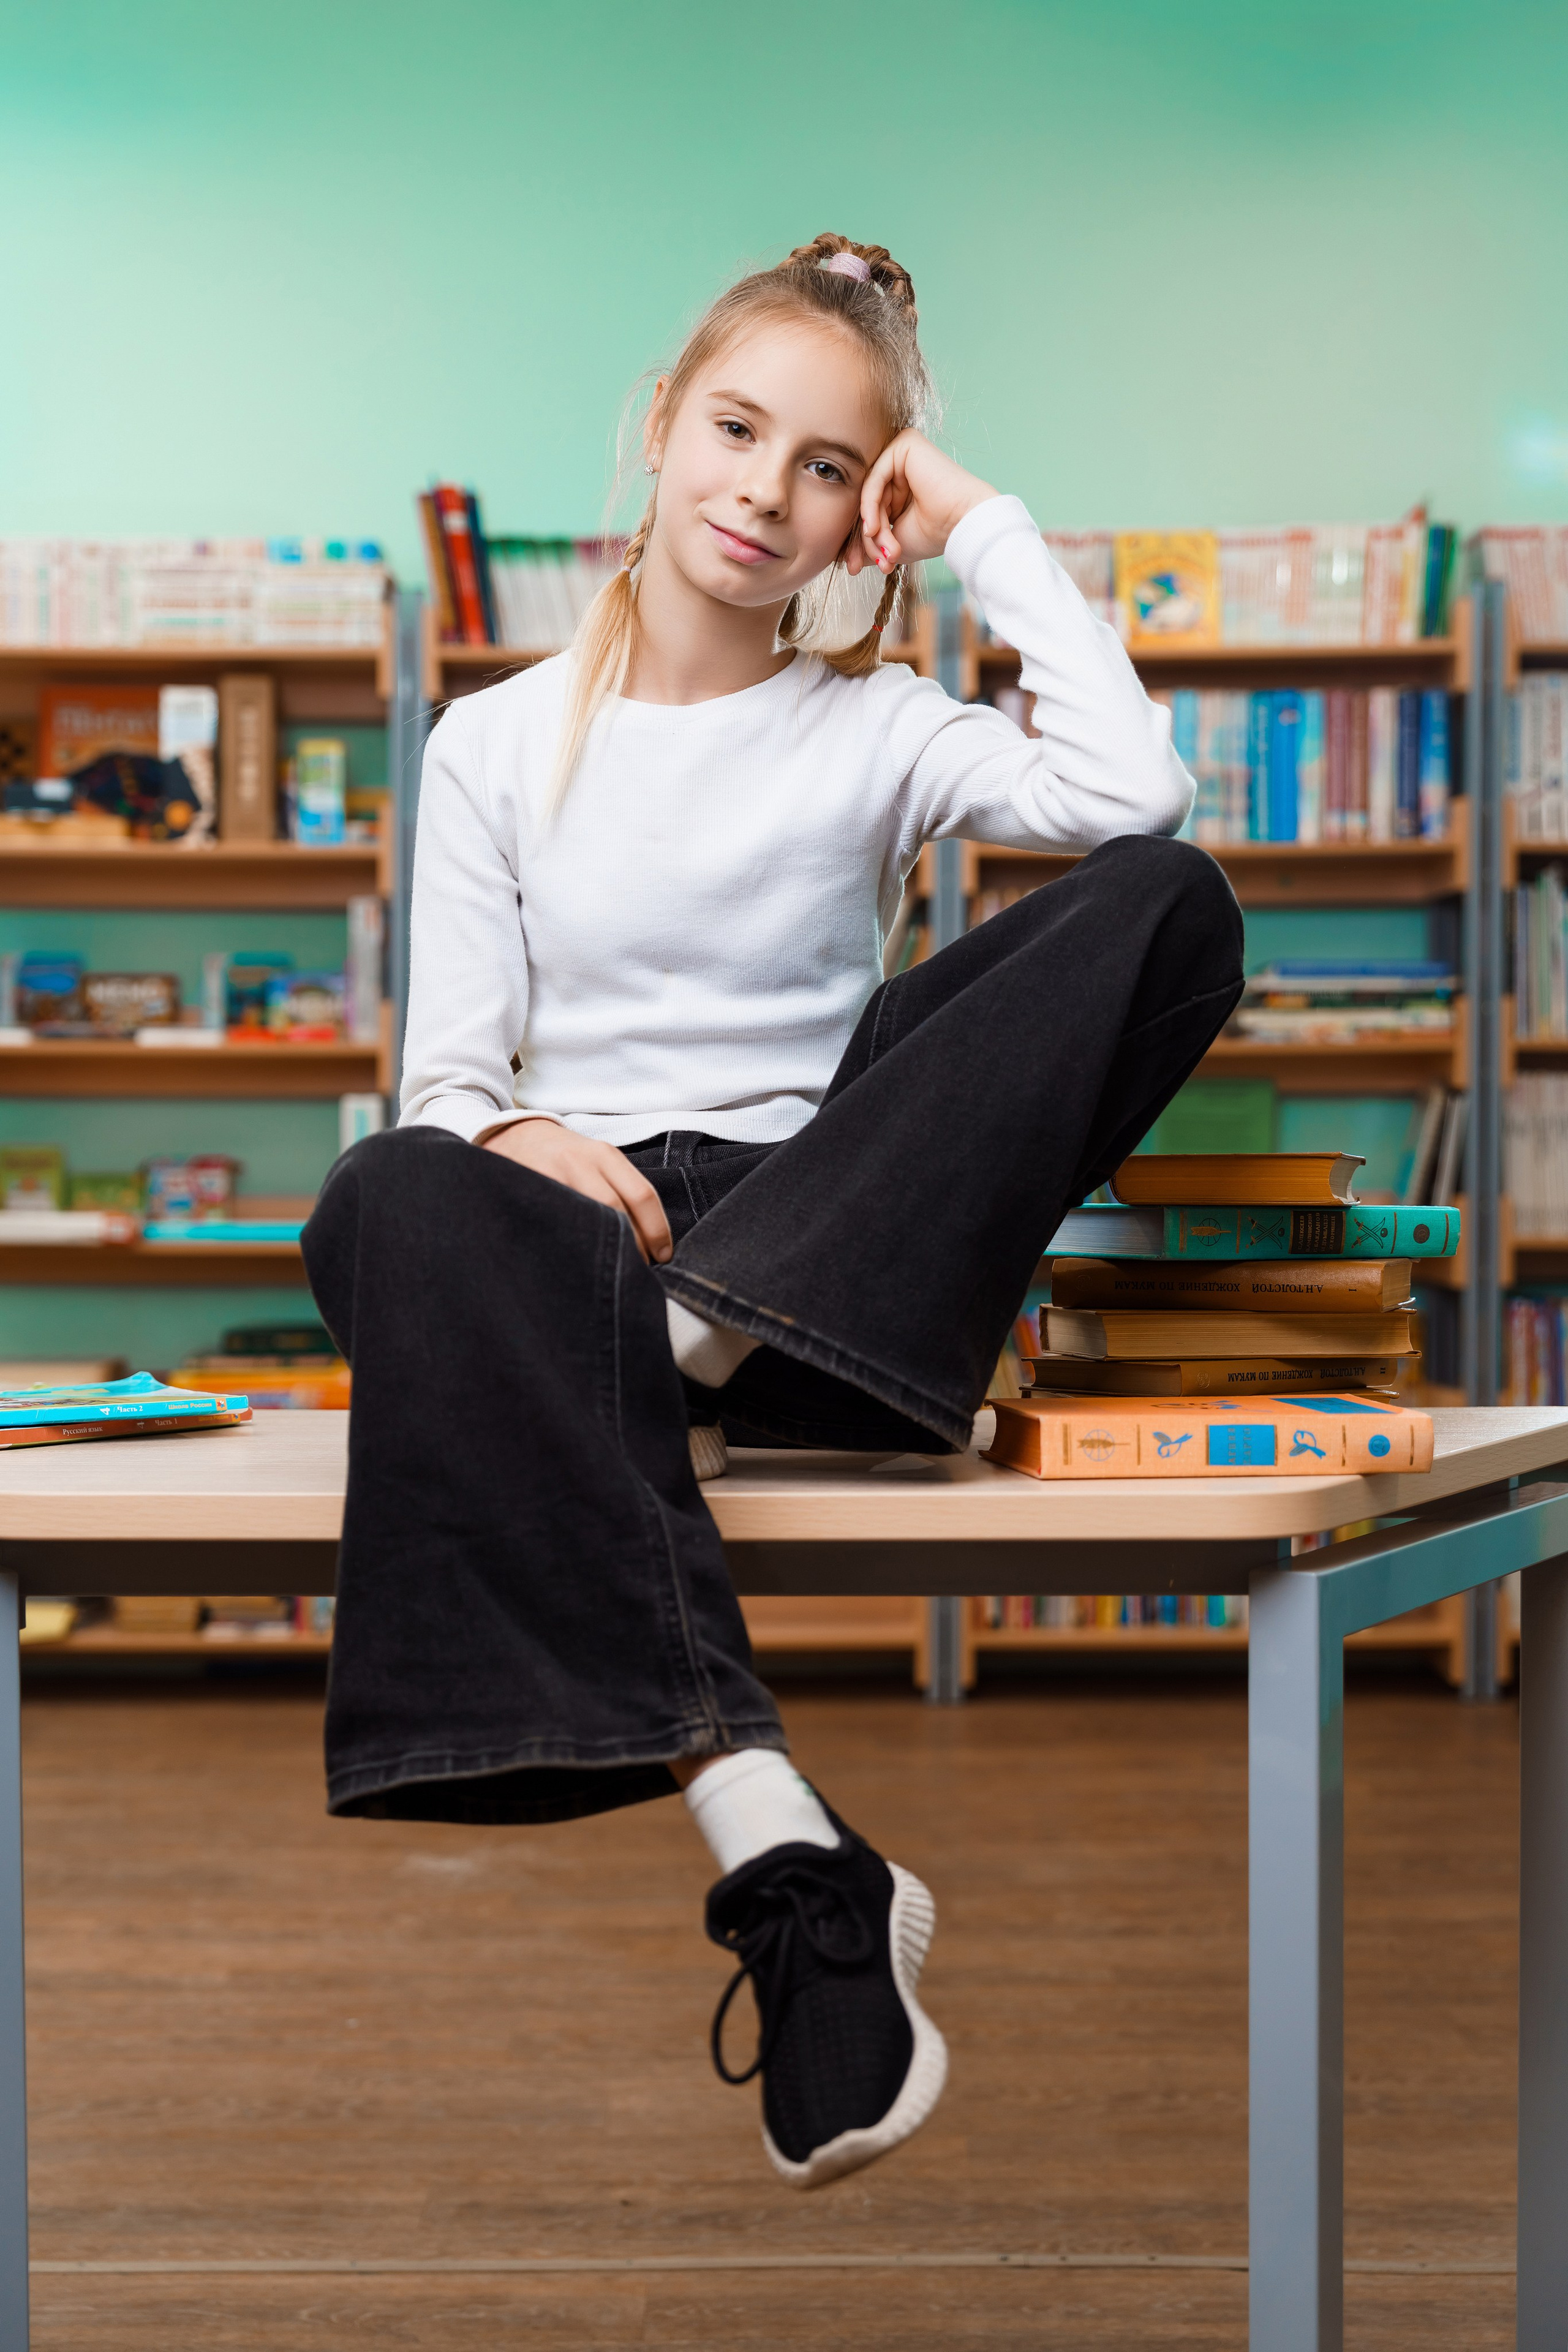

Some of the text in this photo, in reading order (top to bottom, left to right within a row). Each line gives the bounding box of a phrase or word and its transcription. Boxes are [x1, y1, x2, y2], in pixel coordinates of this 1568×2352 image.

[1115, 1281, 1324, 1294] А.Н.ТОЛСТОЙ ХОЖДЕНИЕ ПО МУКАМ
[1227, 1372, 1256, 1382] МУКАМ
[1259, 1371, 1269, 1381] ПО
[1272, 1369, 1313, 1380] ХОЖДЕНИЕ
[62, 1427, 87, 1436] Русский
